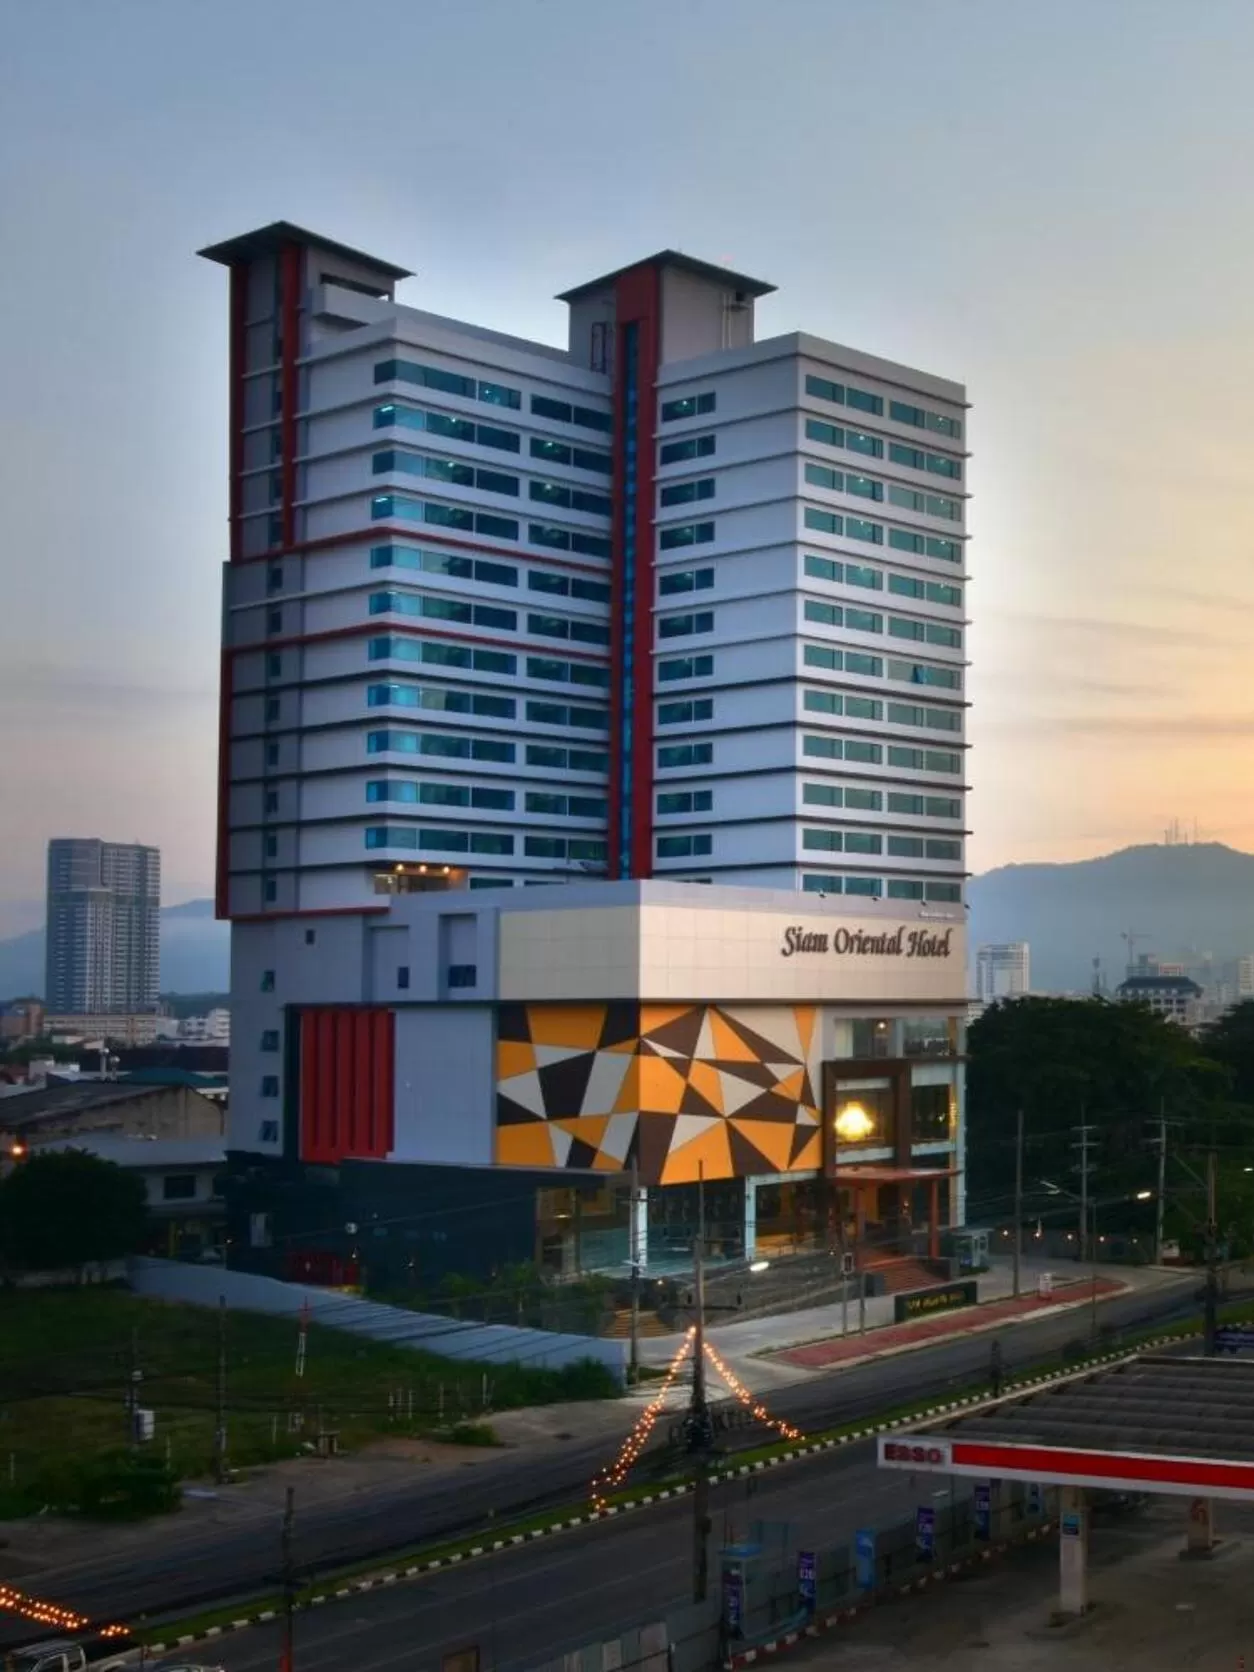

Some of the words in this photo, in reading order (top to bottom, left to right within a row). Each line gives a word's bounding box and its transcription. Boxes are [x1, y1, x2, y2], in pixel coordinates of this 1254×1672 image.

[781, 926, 828, 956] Siam
[834, 925, 905, 955] Oriental
[907, 926, 952, 957] Hotel
